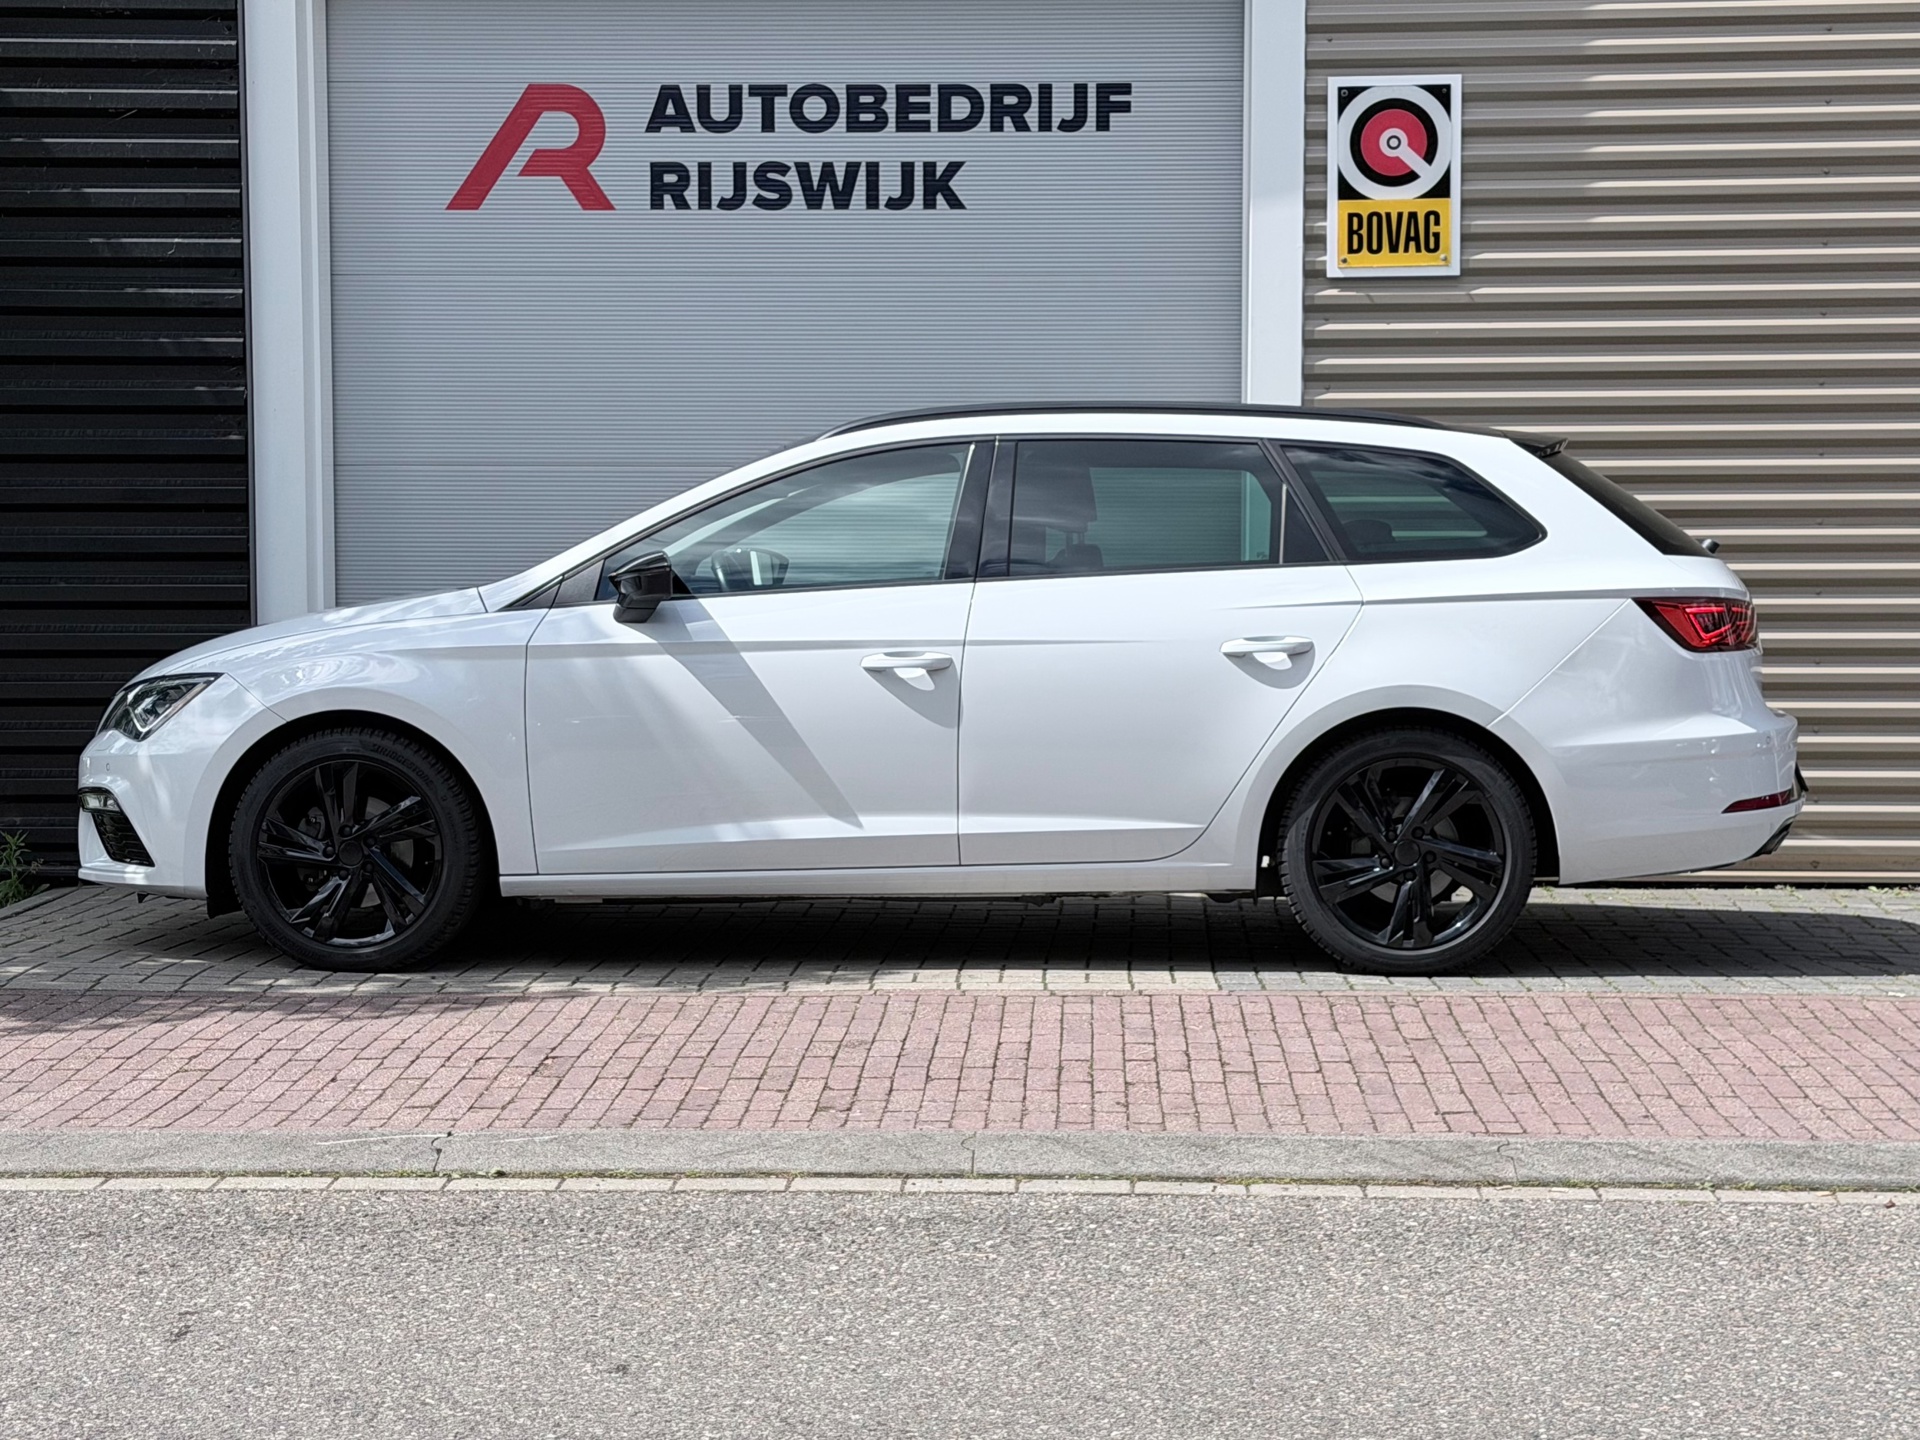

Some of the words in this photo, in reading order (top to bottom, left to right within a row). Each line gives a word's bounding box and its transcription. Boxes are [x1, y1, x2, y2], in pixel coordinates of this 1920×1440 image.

[645, 83, 1132, 133] AUTOBEDRIJF
[649, 161, 968, 211] RIJSWIJK
[1347, 210, 1441, 254] BOVAG
